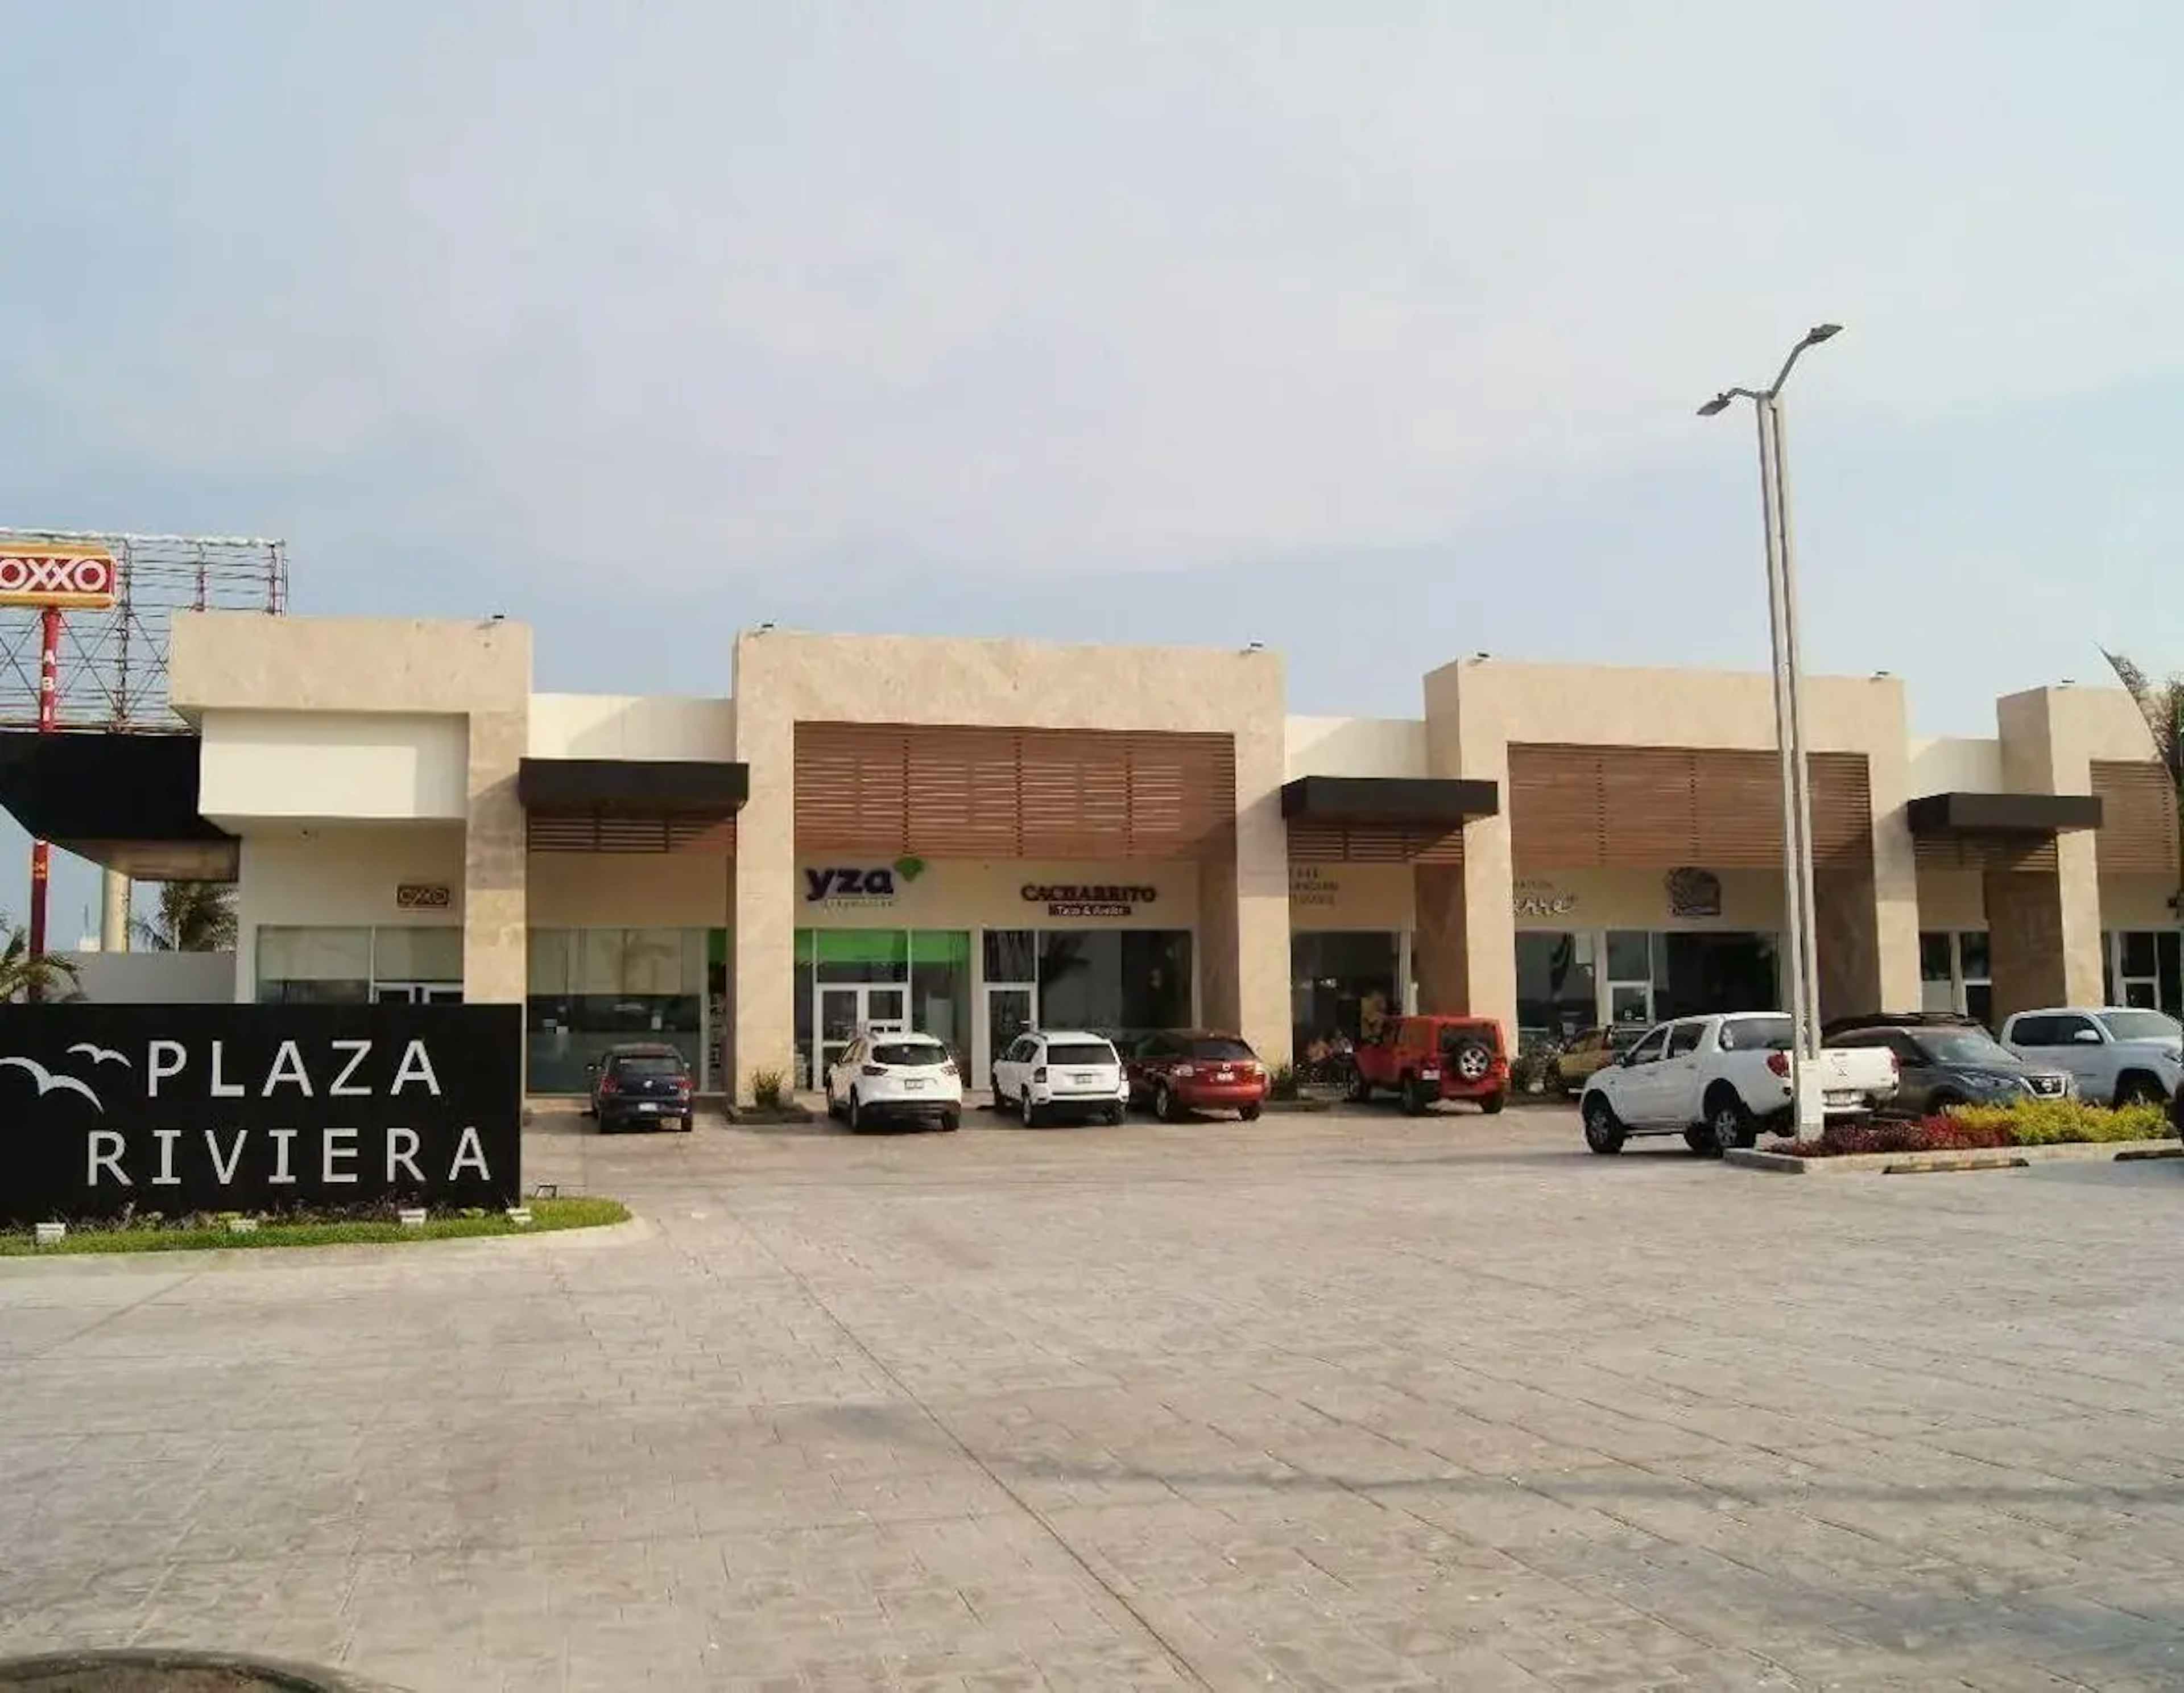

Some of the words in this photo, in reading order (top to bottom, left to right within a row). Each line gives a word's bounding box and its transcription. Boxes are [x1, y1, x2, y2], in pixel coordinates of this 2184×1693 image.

[0, 558, 107, 592] OXXO
[805, 867, 894, 901] yza
[147, 1040, 442, 1097] PLAZA
[86, 1127, 493, 1186] RIVIERA
